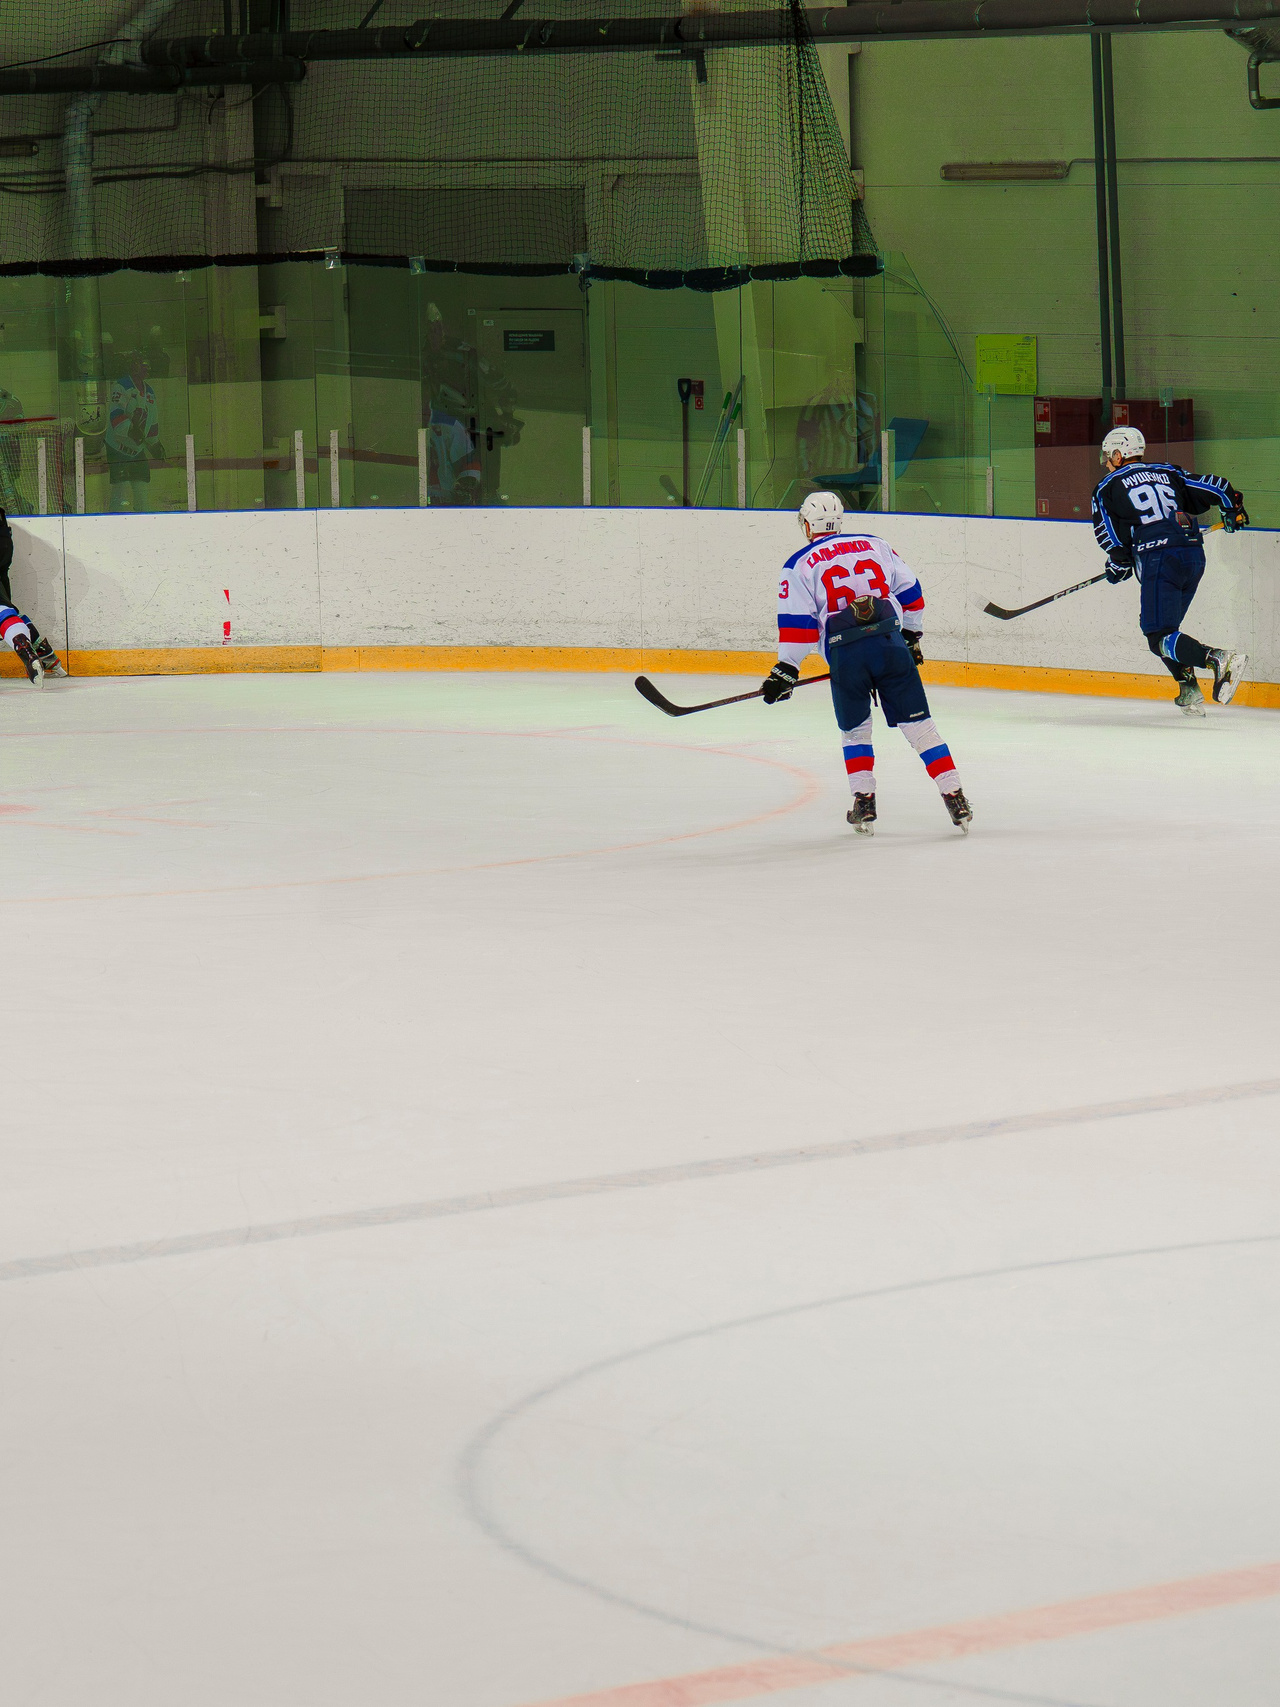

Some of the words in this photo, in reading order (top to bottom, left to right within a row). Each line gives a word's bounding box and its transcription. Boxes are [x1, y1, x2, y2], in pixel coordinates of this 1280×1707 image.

[1121, 471, 1170, 489] МУЩЕНКО
[1128, 484, 1178, 525] 96
[825, 522, 835, 531] 91
[1137, 538, 1169, 552] CCM
[778, 580, 789, 599] 3
[821, 558, 890, 613] 63
[1053, 579, 1092, 601] CCM
